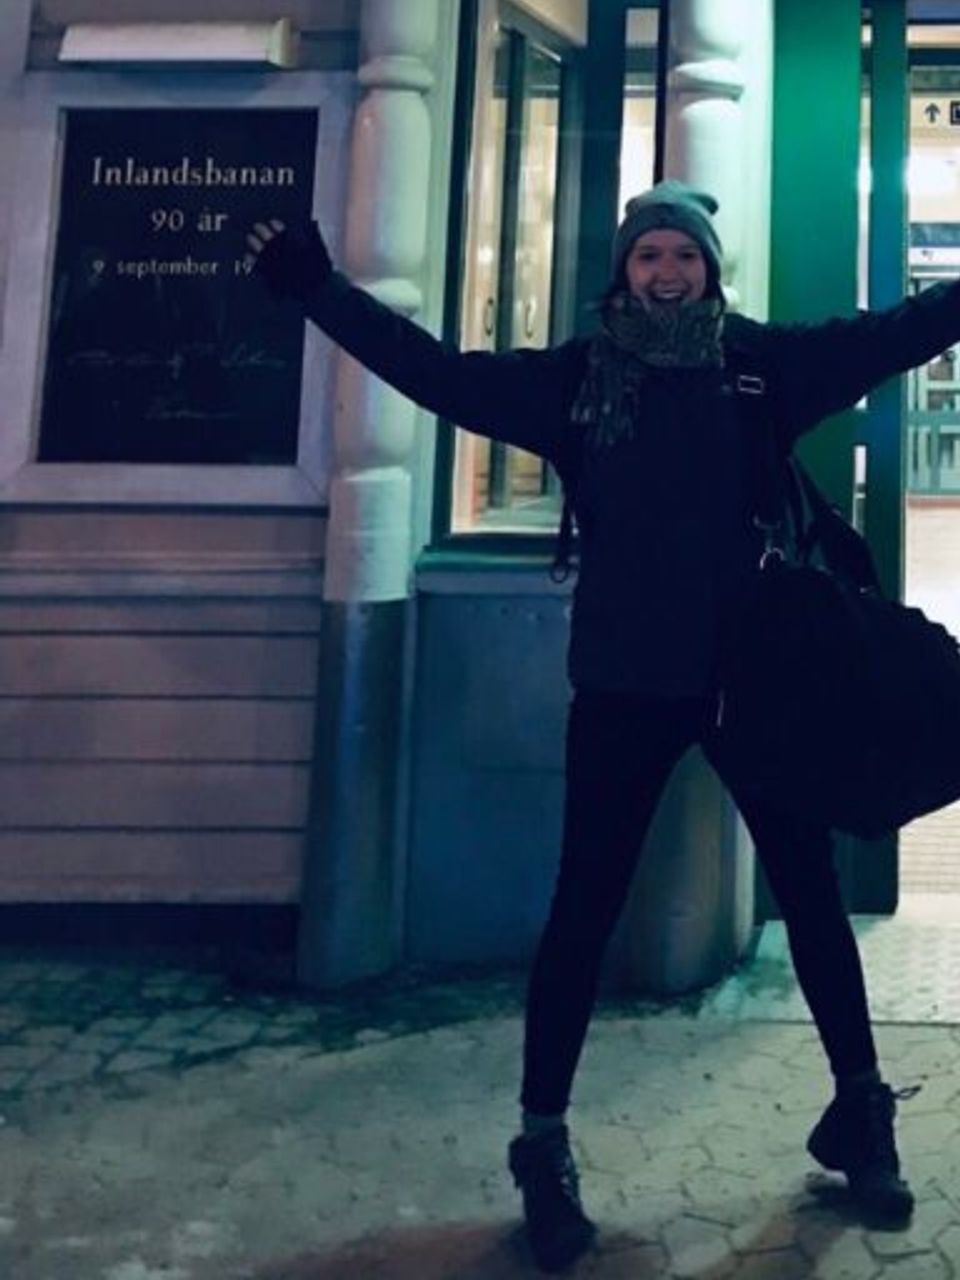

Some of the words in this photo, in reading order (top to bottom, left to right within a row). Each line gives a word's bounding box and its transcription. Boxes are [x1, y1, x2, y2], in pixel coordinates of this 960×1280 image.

[92, 156, 295, 187] Inlandsbanan
[150, 209, 185, 232] 90
[197, 205, 229, 233] år
[92, 258, 106, 274] 9
[116, 255, 219, 280] september
